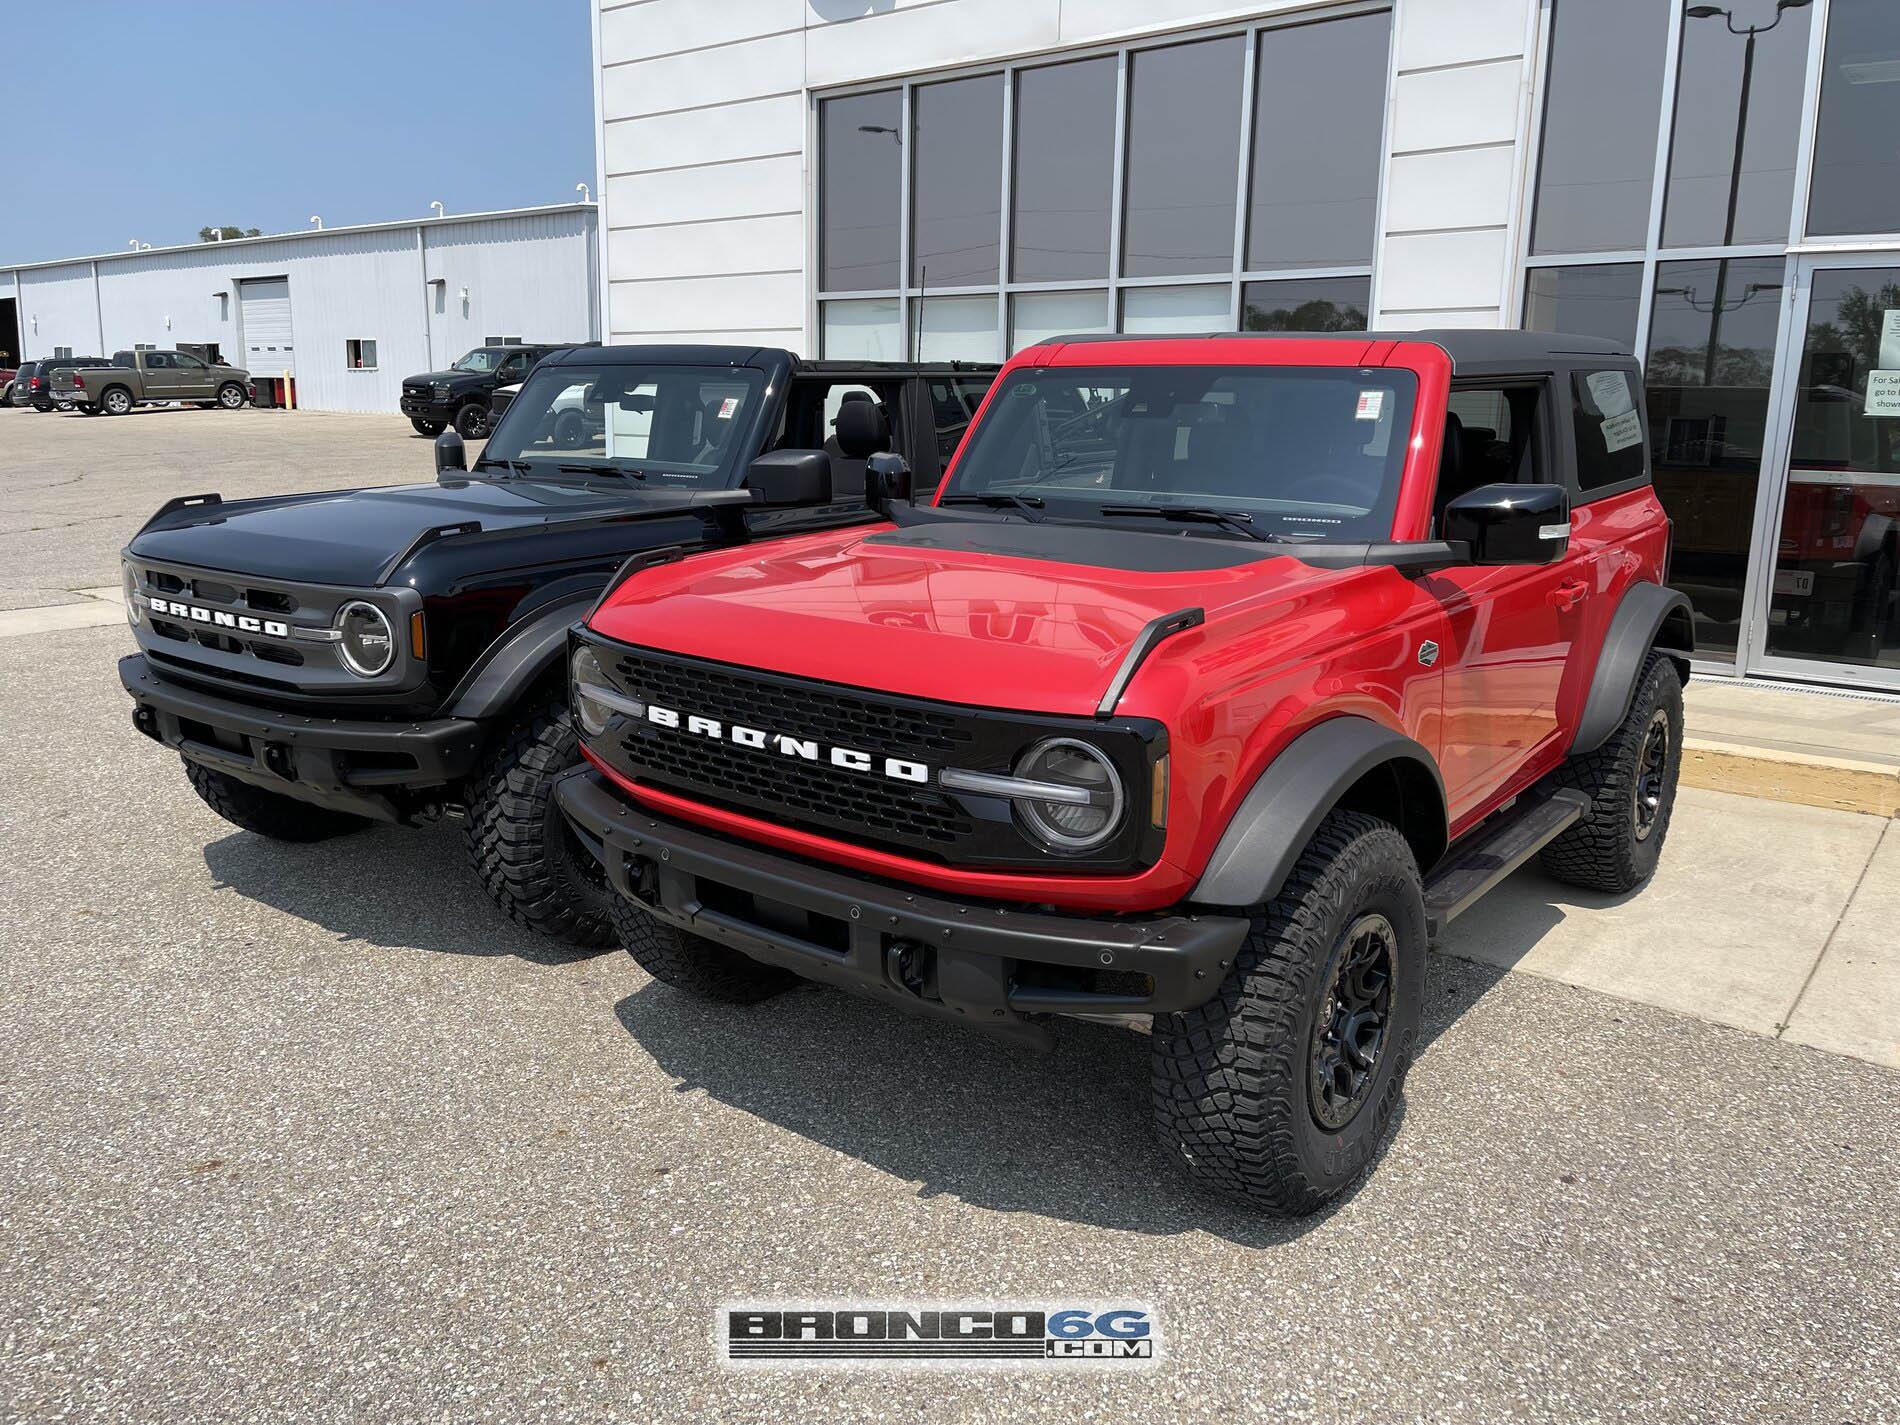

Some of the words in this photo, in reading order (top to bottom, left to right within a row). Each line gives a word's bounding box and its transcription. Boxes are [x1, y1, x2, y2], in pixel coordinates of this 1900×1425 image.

[1873, 376, 1887, 384] For
[150, 597, 288, 637] BRONCO
[648, 705, 928, 783] BRONCO
